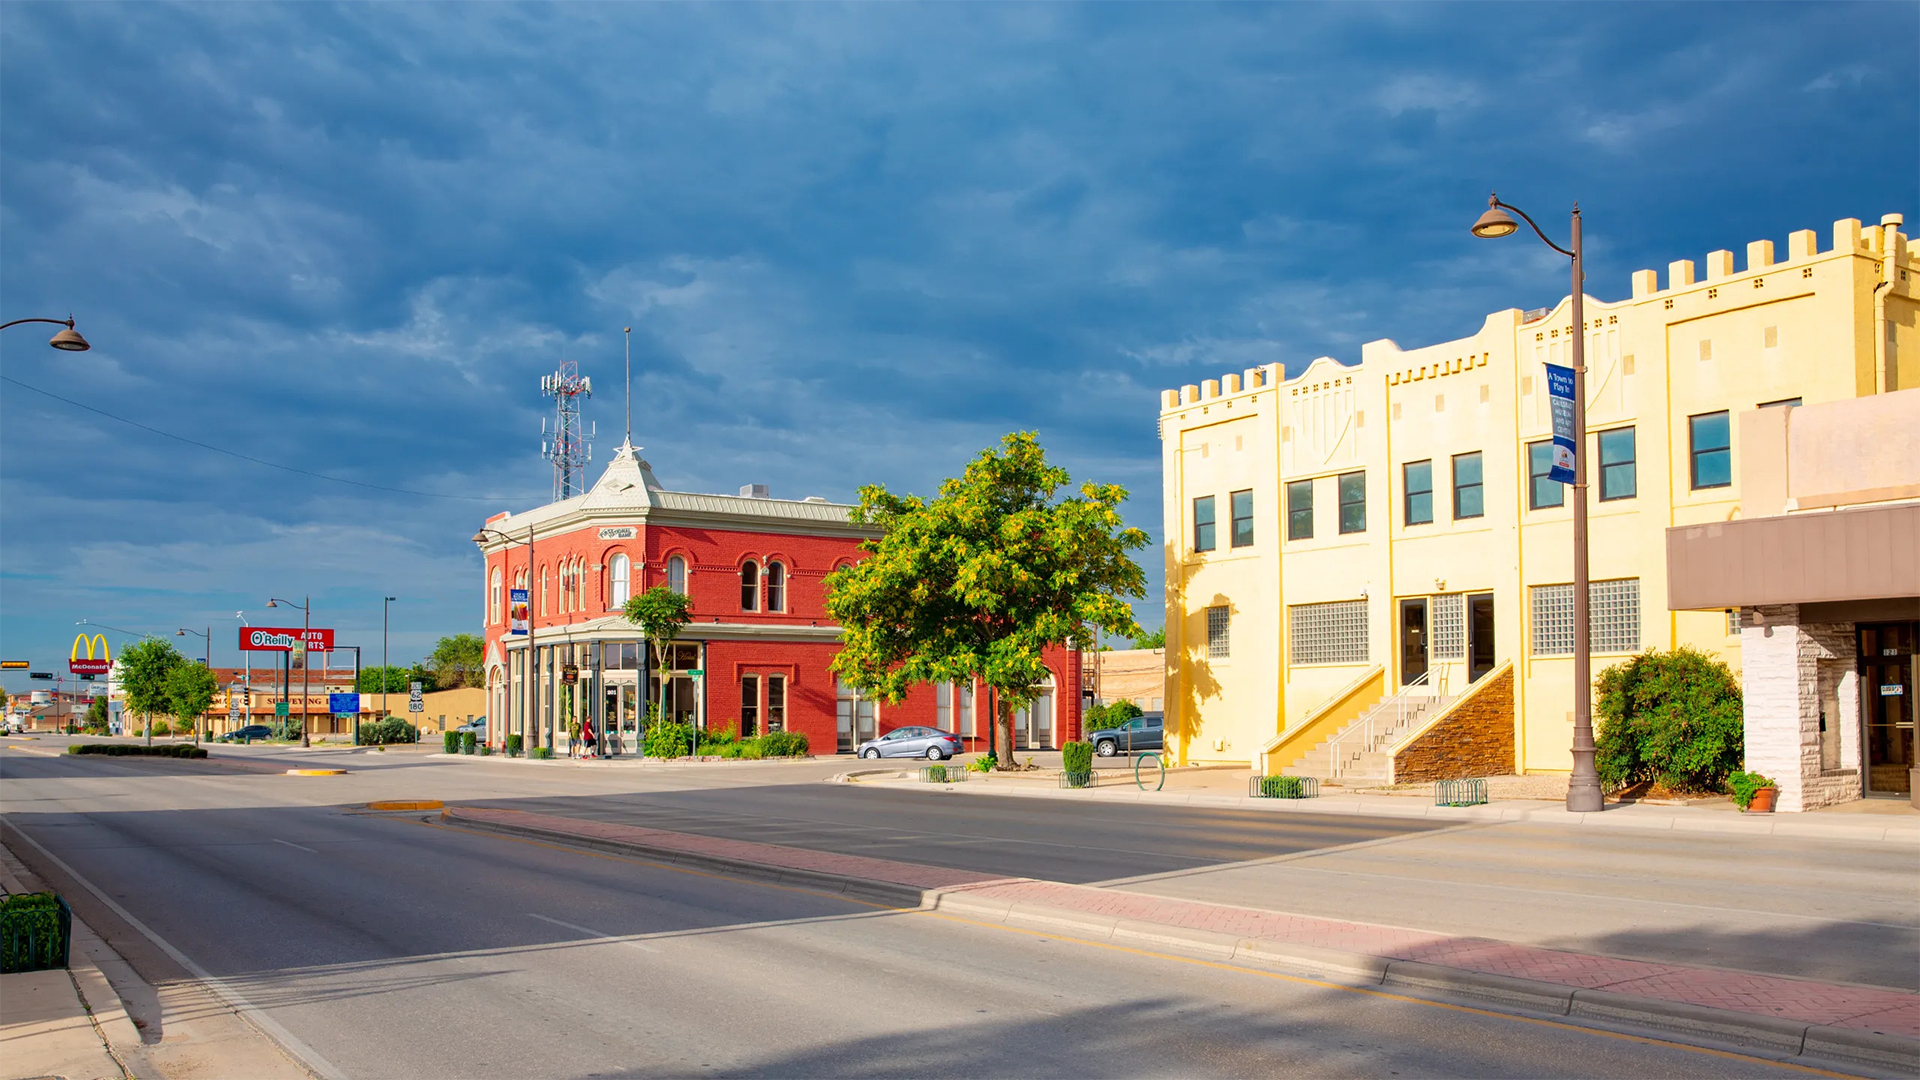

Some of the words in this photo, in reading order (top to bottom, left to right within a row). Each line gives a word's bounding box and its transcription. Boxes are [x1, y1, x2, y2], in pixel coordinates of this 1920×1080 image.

[1548, 372, 1553, 381] A
[1553, 373, 1567, 383] Town
[1553, 382, 1564, 393] Play
[251, 631, 295, 648] O'Reilly
[301, 632, 323, 640] AUTO
